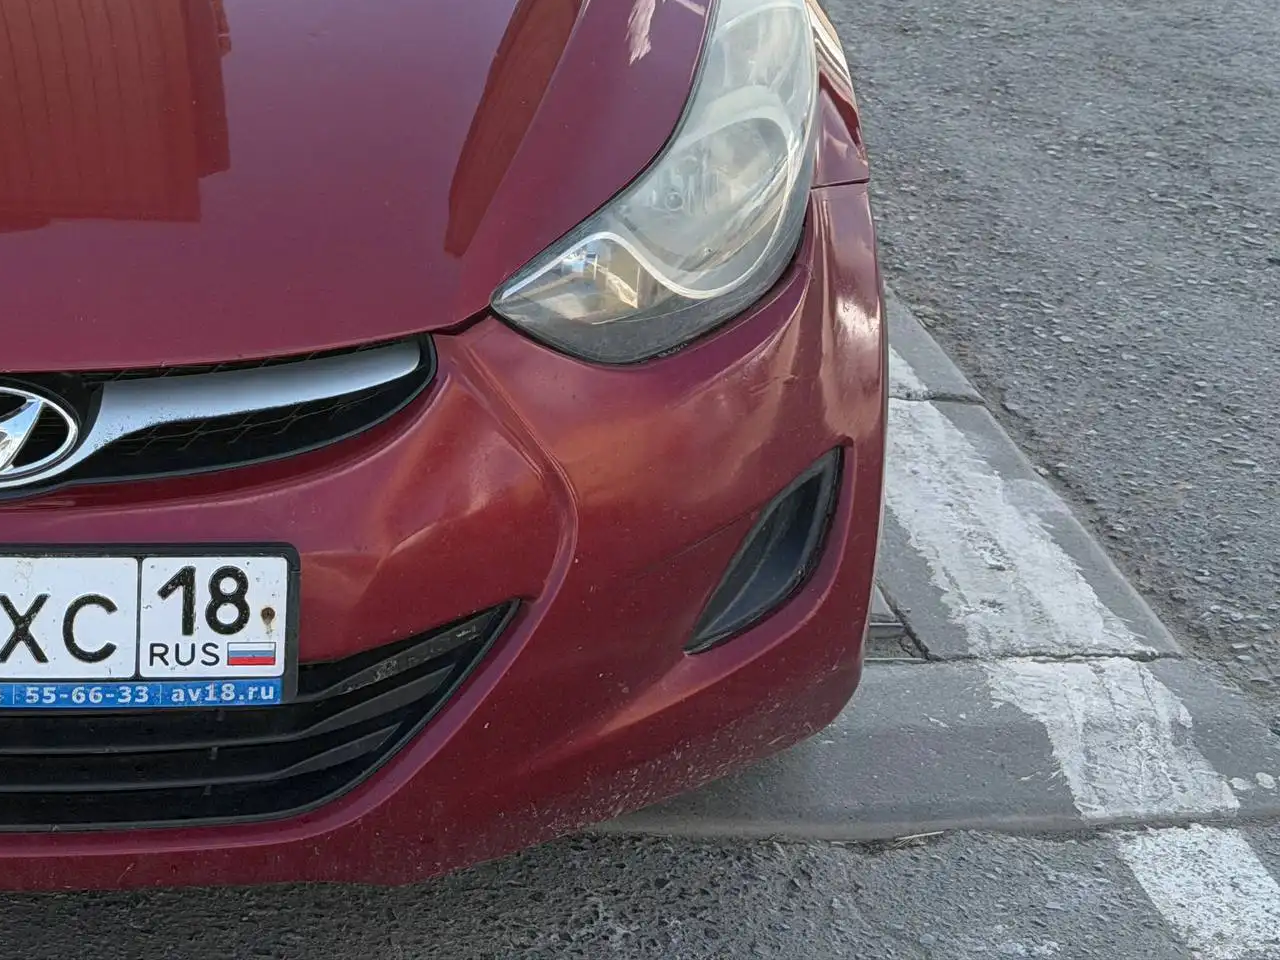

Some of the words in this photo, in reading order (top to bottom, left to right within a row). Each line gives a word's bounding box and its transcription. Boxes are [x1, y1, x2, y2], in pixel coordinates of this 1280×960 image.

[157, 564, 251, 637] 18
[148, 642, 221, 667] RUS
[25, 685, 150, 705] 55-66-33
[170, 682, 275, 704] av18.ru
